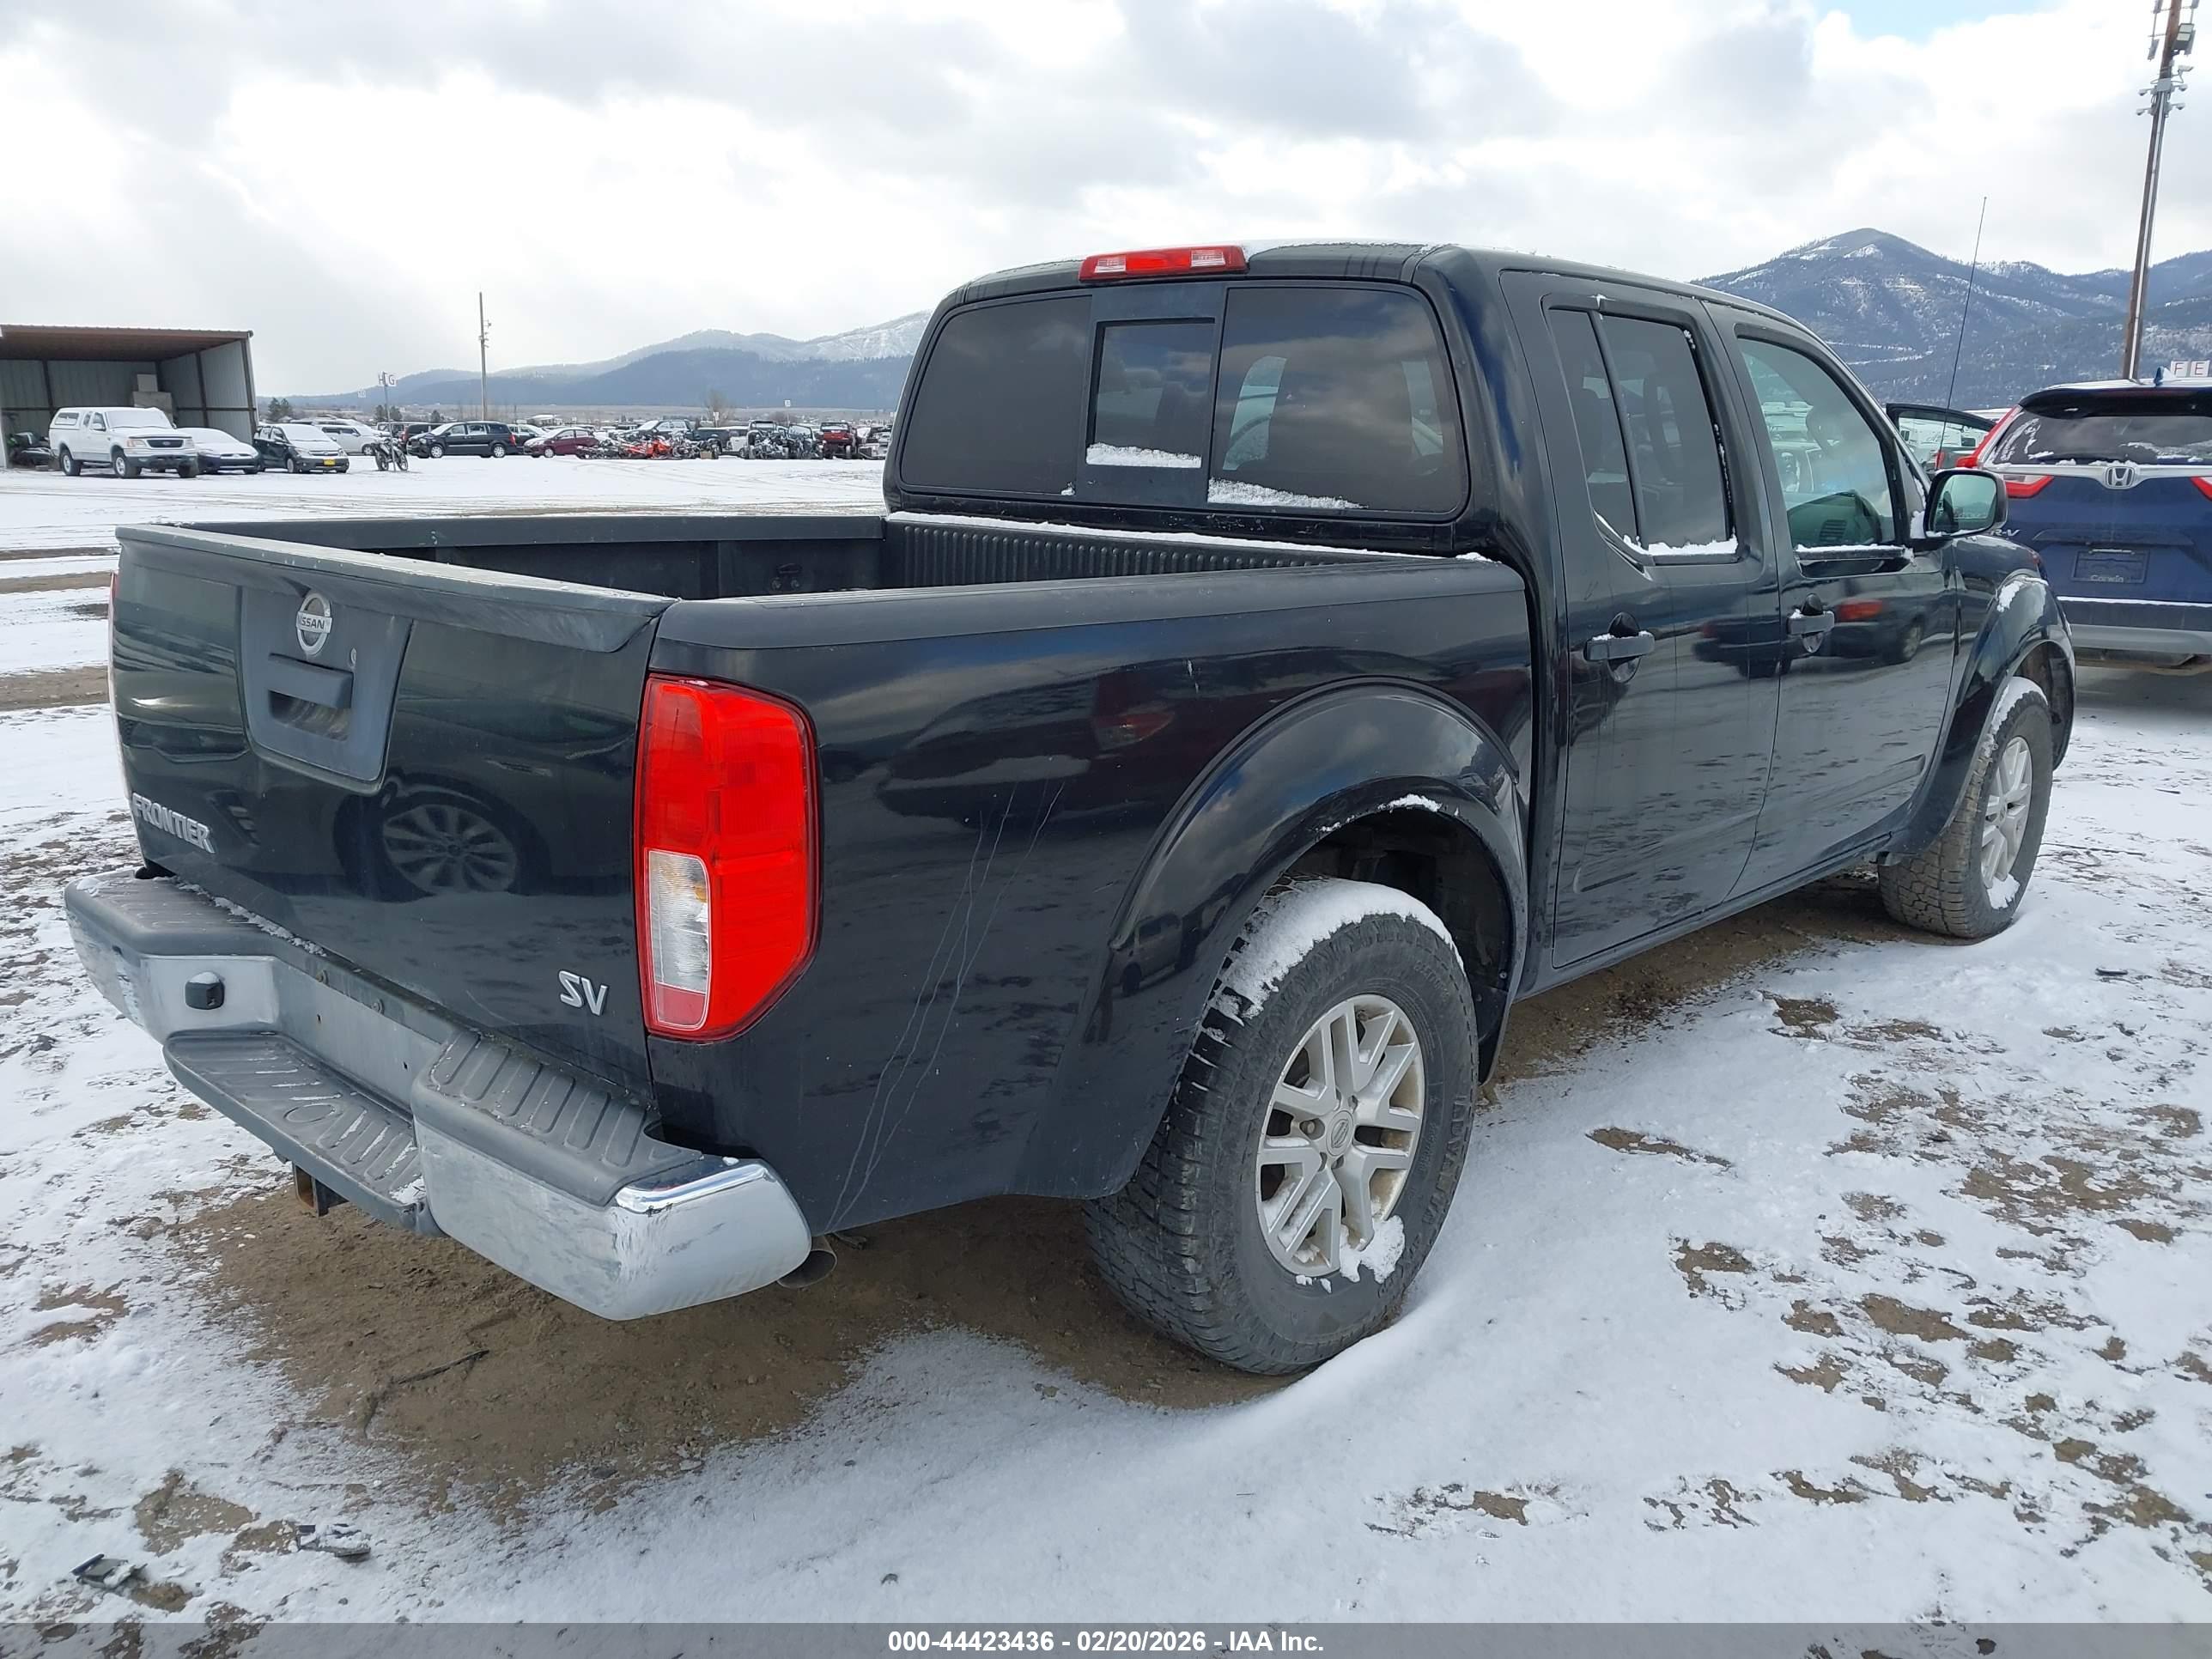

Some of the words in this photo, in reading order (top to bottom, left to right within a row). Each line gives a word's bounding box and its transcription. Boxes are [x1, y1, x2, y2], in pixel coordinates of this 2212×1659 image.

[2173, 362, 2185, 375] F
[2194, 362, 2206, 375] E
[132, 792, 216, 854] FRONTIER
[558, 970, 608, 1016] SV
